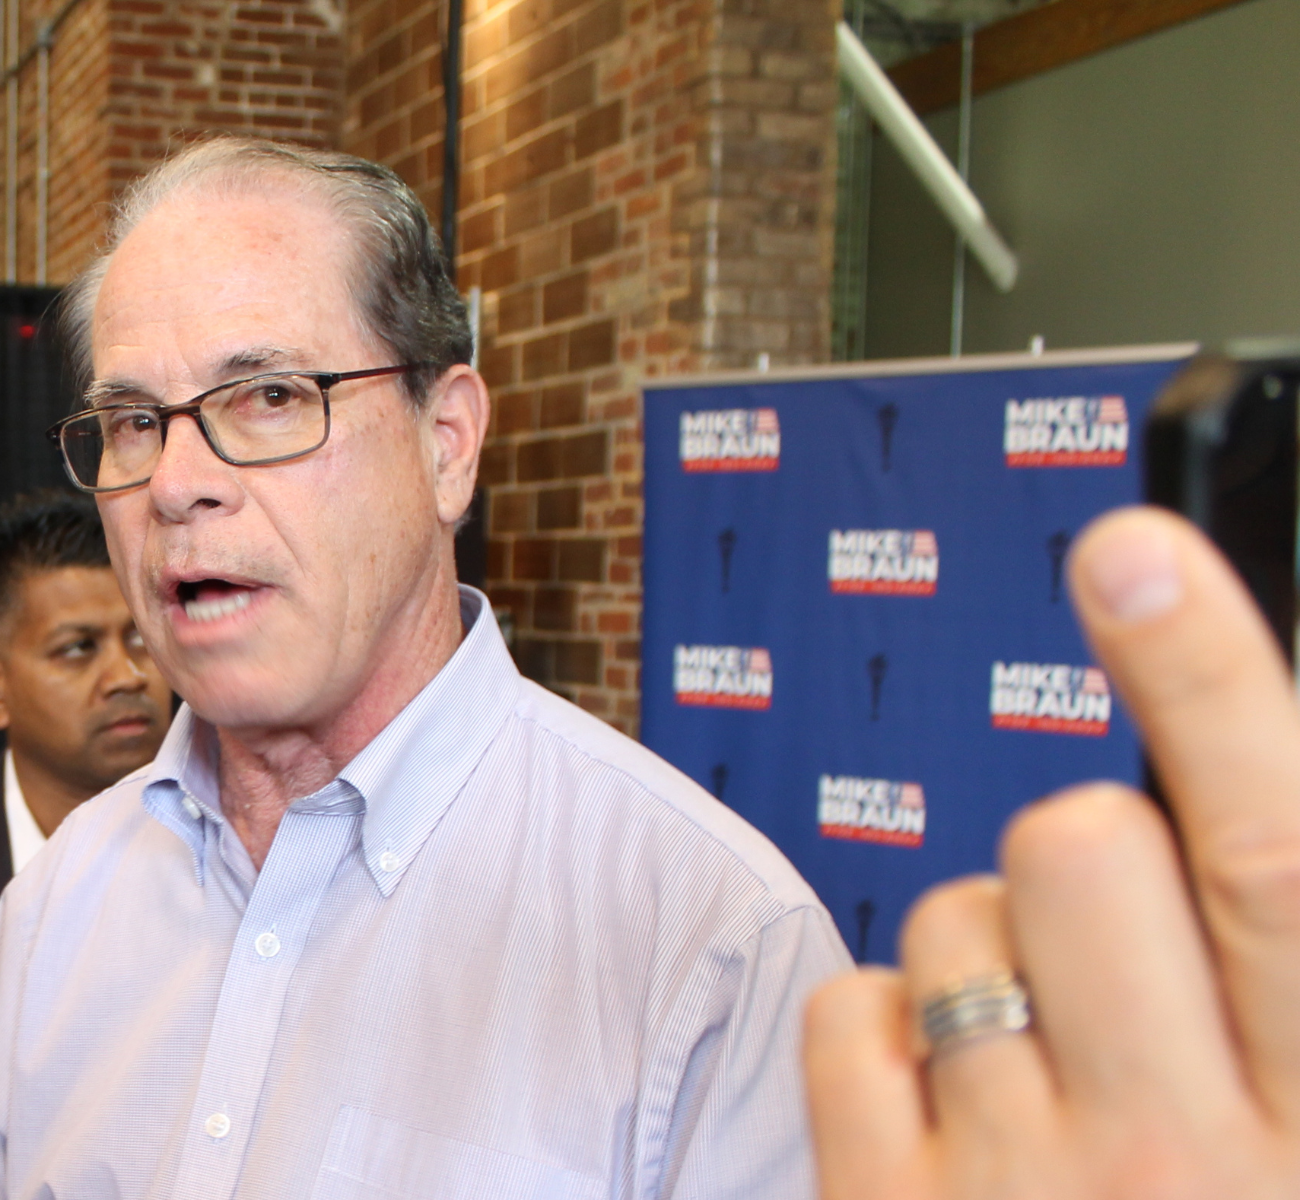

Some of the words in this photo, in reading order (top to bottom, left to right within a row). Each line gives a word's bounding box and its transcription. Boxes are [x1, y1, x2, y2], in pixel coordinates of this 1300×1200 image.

[680, 409, 746, 433] MIKE
[1004, 397, 1086, 425] MIKE
[680, 432, 780, 459] BRAUN
[1003, 421, 1128, 453] BRAUN
[828, 530, 902, 557] MIKE
[827, 554, 939, 582] BRAUN
[674, 644, 741, 672] MIKE
[673, 669, 773, 697] BRAUN
[991, 661, 1072, 694] MIKE
[990, 686, 1111, 722] BRAUN
[818, 774, 890, 806] MIKE
[817, 799, 926, 835] BRAUN
